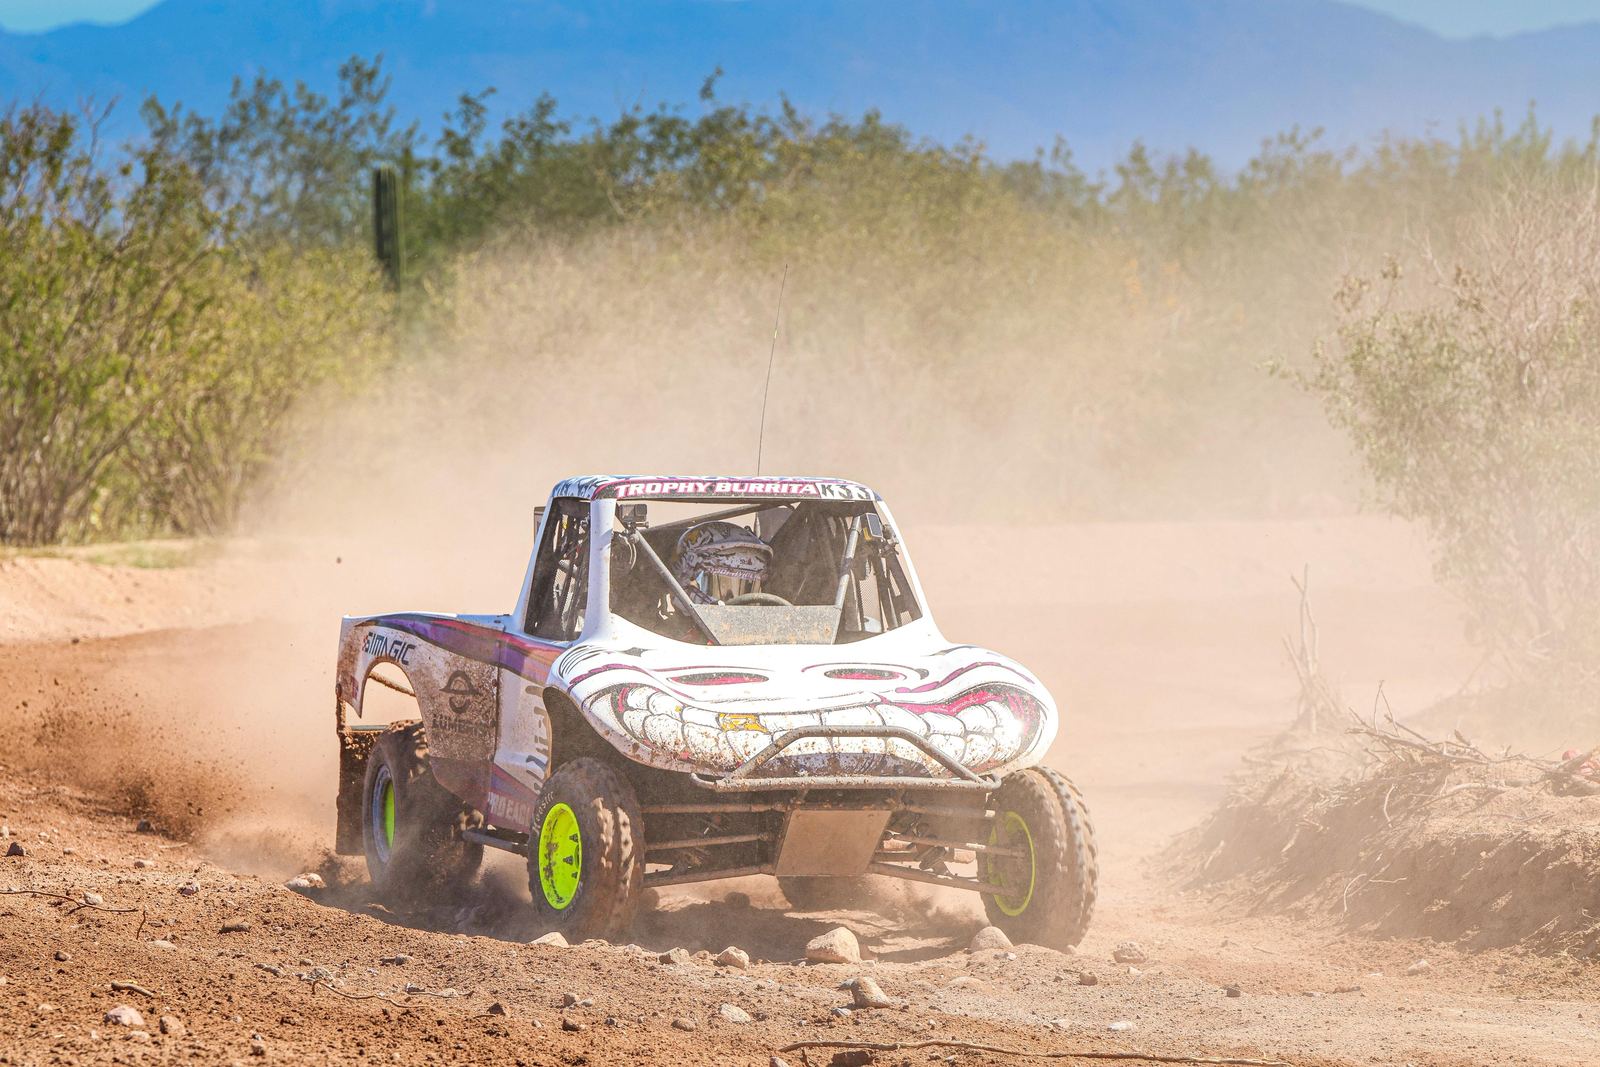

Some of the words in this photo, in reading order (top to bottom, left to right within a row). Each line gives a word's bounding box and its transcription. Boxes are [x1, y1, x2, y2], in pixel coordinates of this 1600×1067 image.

[614, 481, 712, 499] TROPHY
[714, 481, 819, 496] BURRITA
[362, 631, 416, 666] SIMAGIC
